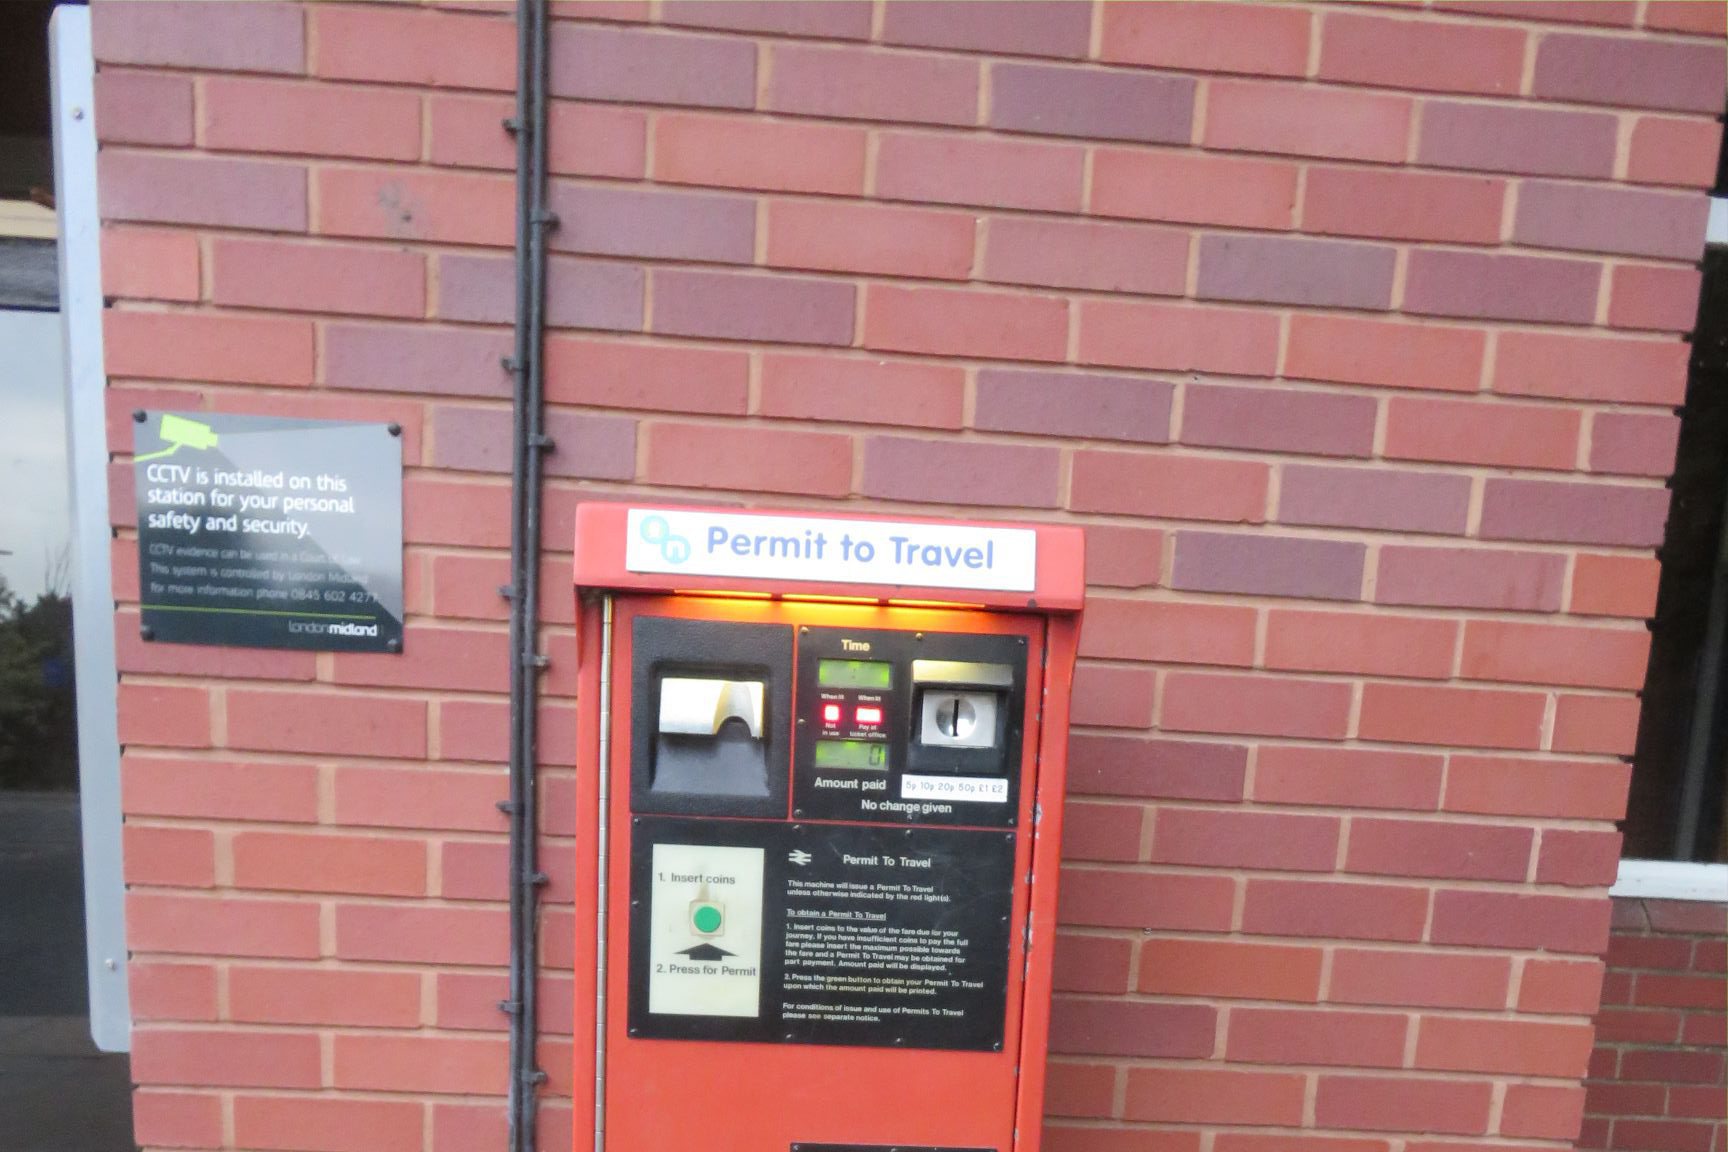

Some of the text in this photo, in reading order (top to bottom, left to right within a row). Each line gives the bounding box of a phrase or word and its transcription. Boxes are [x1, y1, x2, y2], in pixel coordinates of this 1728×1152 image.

[147, 463, 348, 492] CCTV is installed on this
[148, 487, 356, 515] station for your personal
[148, 510, 311, 539] safety and security.
[708, 526, 994, 569] Permit to Travel
[841, 639, 871, 651] Time
[814, 776, 887, 791] Amount paid
[906, 781, 1004, 793] 5p 10p 20p 50p £1 £2
[861, 799, 952, 814] No change given
[843, 854, 931, 868] Permit To Travel
[658, 873, 736, 885] 1. Insert coins
[788, 880, 803, 888] This
[912, 885, 933, 893] Travel
[812, 890, 848, 898] otherwise
[850, 891, 883, 899] indicated
[924, 894, 951, 903] light(s).
[828, 910, 852, 918] Permit
[865, 912, 886, 920] Travel
[846, 925, 858, 933] the
[943, 930, 958, 938] your
[785, 932, 815, 941] journey.
[823, 934, 836, 942] you
[856, 935, 897, 943] insufficient
[956, 938, 968, 946] full
[836, 951, 860, 959] Permit
[894, 954, 909, 962] may
[921, 955, 953, 963] obtained
[656, 964, 756, 976] 2. Press for Permit
[784, 958, 800, 966] part
[802, 959, 836, 967] payment.
[838, 960, 866, 968] Amount
[867, 961, 884, 969] paid
[910, 963, 947, 971] displayed.
[791, 973, 812, 981] Press
[826, 975, 847, 983] green
[847, 975, 871, 984] button
[881, 977, 904, 985] obtain
[924, 978, 948, 987] Permit
[961, 980, 983, 988] Travel
[783, 983, 801, 991] upon
[802, 983, 824, 991] which
[908, 987, 937, 995] printed.
[782, 1002, 795, 1010] For
[796, 1003, 834, 1011] conditions
[863, 1005, 877, 1013] and
[901, 1007, 930, 1015] Permits
[942, 1008, 964, 1016] Travel
